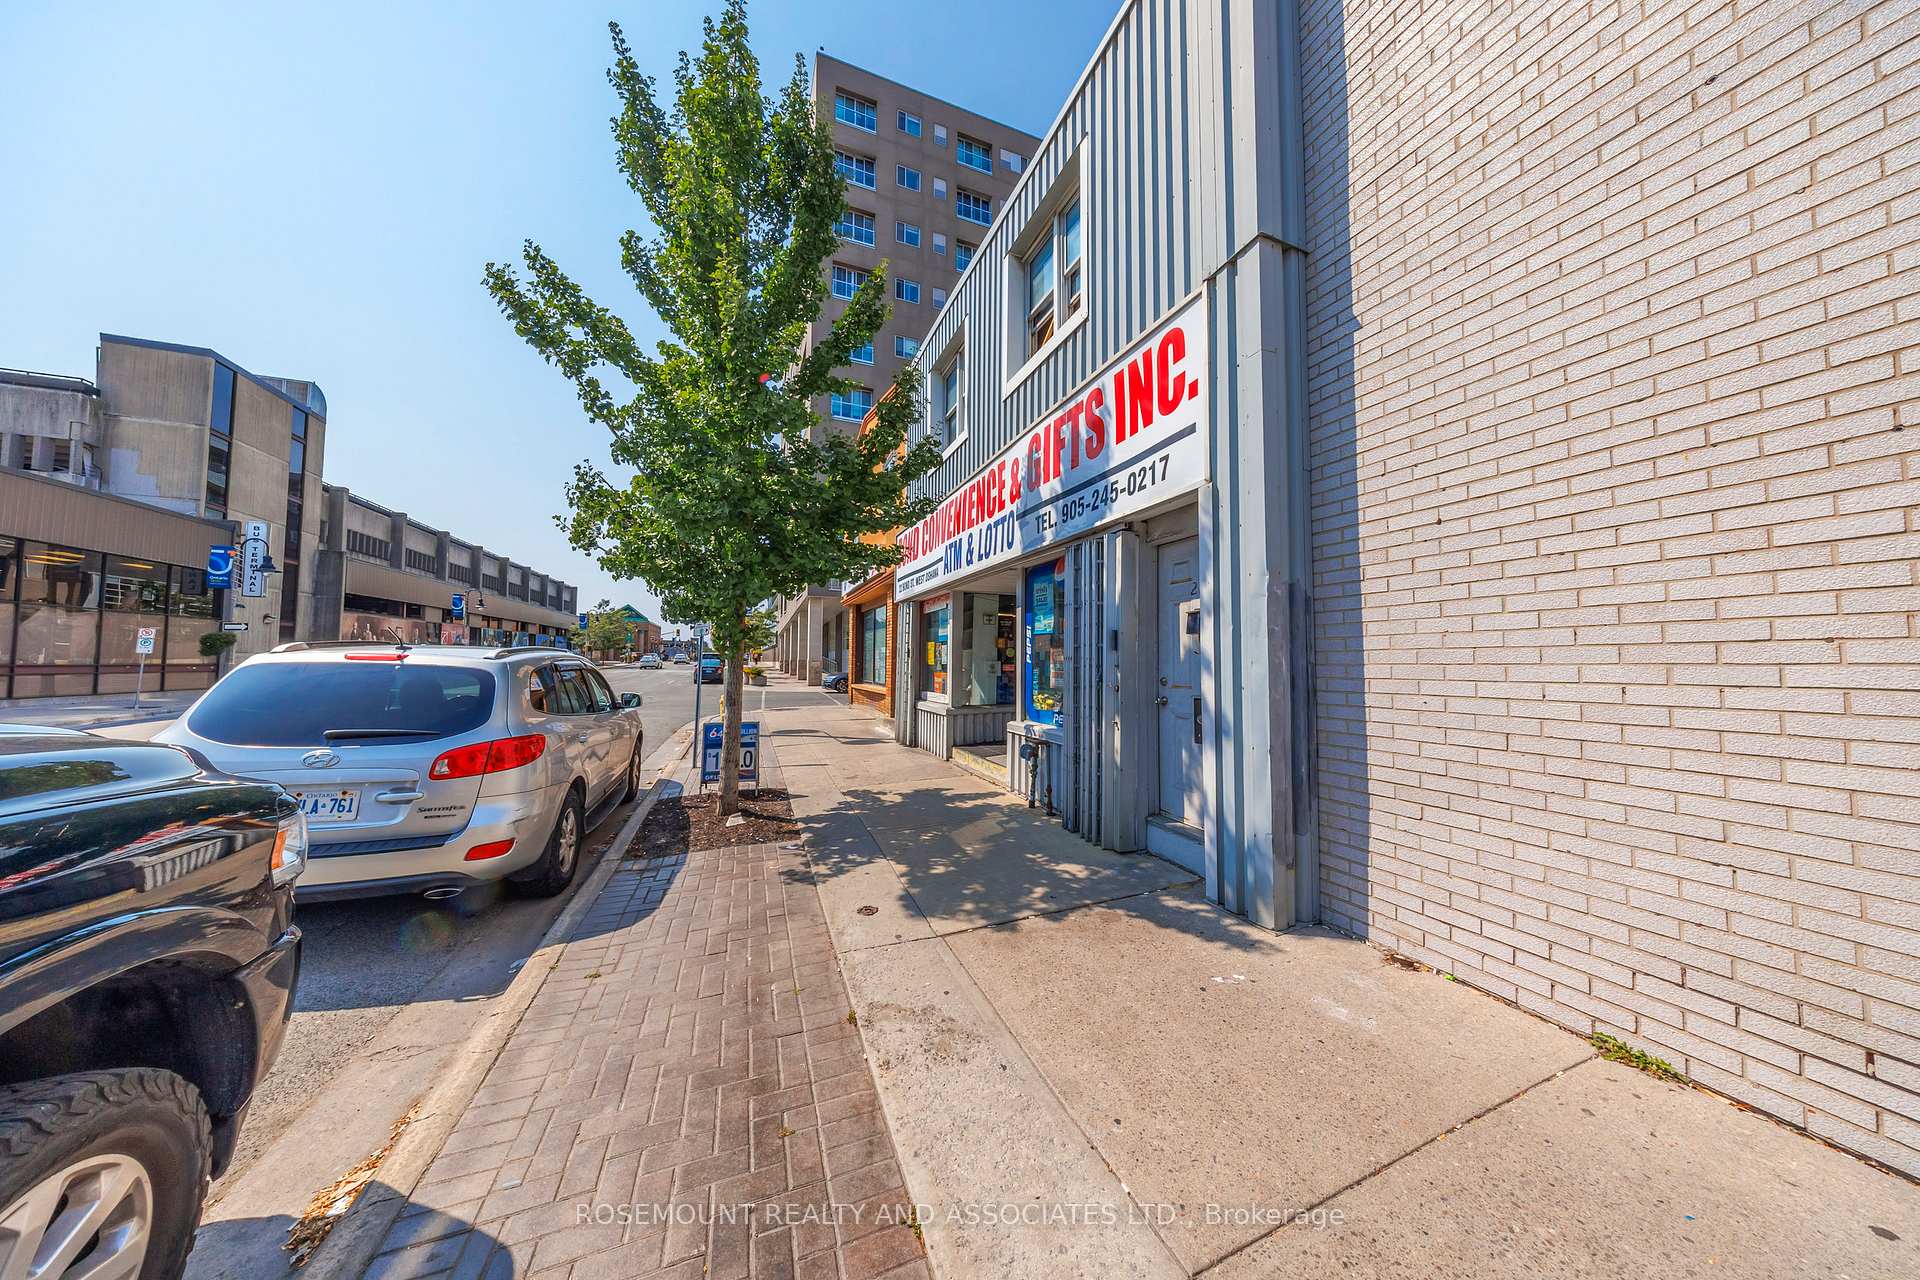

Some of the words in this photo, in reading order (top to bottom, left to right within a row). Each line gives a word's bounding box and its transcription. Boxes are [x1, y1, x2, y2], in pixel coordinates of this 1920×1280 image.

[922, 459, 1006, 556] CONVENIENCE
[1009, 457, 1022, 505] &
[1027, 387, 1106, 493] GIFTS
[1113, 327, 1199, 445] INC.
[1035, 511, 1058, 534] TEL.
[1062, 453, 1170, 524] 905-245-0217
[249, 546, 260, 593] TERMINAL
[943, 537, 963, 576] ATM
[966, 532, 974, 567] &
[978, 510, 1015, 562] LOTTO
[915, 574, 925, 586] WEST
[330, 797, 354, 814] 761
